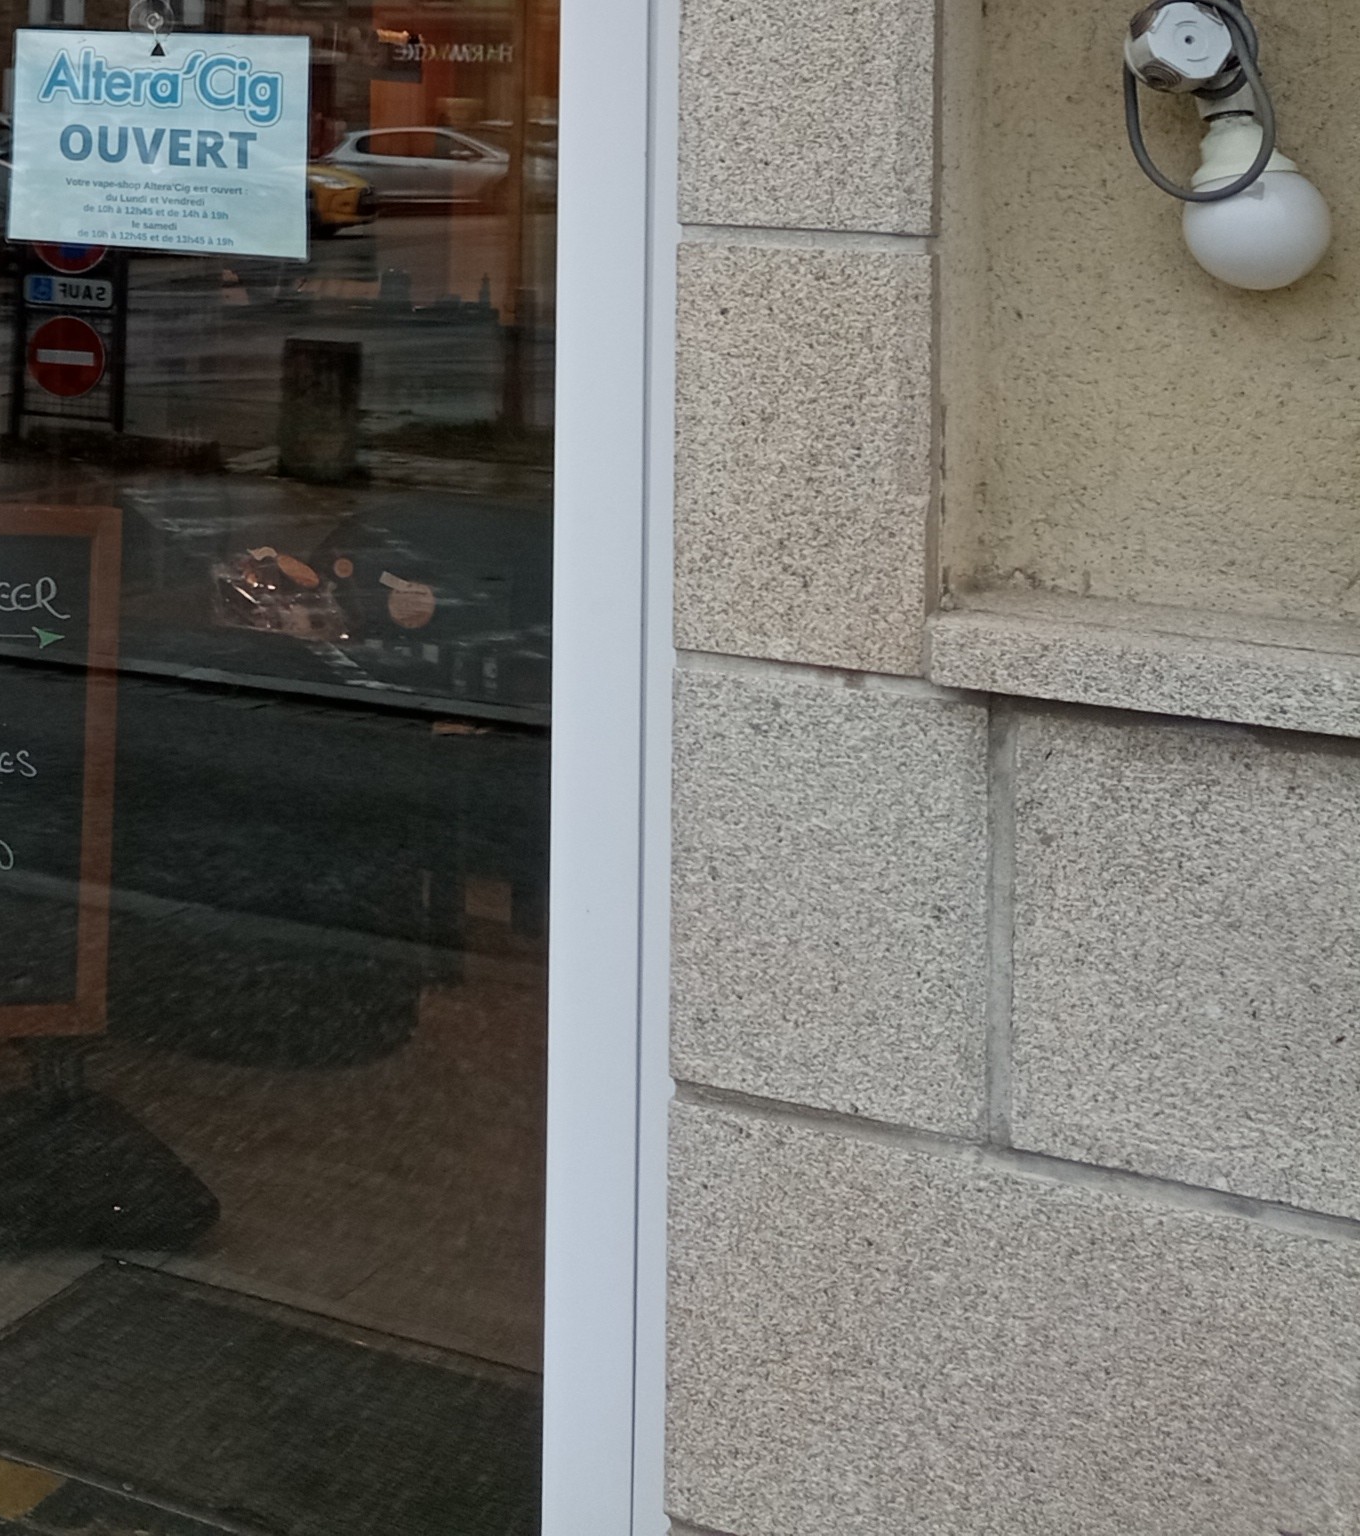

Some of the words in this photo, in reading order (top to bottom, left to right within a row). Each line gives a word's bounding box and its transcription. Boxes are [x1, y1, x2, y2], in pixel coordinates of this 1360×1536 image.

[39, 47, 282, 126] Altera'Cig
[59, 124, 257, 169] OUVERT
[66, 178, 90, 187] Votre
[92, 179, 141, 191] vape-shop
[143, 181, 190, 194] Altera'Cig
[193, 185, 208, 193] est
[212, 186, 243, 195] ouvert
[105, 193, 118, 202] du
[120, 194, 147, 203] Lundi
[150, 195, 159, 204] et
[161, 196, 205, 207] Vendredi
[83, 203, 94, 212] de
[98, 204, 114, 213] 10h
[116, 205, 122, 214] à
[125, 206, 153, 216] 12h45
[155, 208, 165, 216] et
[167, 207, 179, 217] de
[182, 209, 200, 218] 14h
[202, 210, 208, 219] à
[131, 220, 140, 229] le
[143, 221, 177, 231] samedi
[77, 229, 89, 238] de
[119, 232, 147, 242] 12h45
[150, 234, 159, 242] et
[162, 234, 173, 243] de
